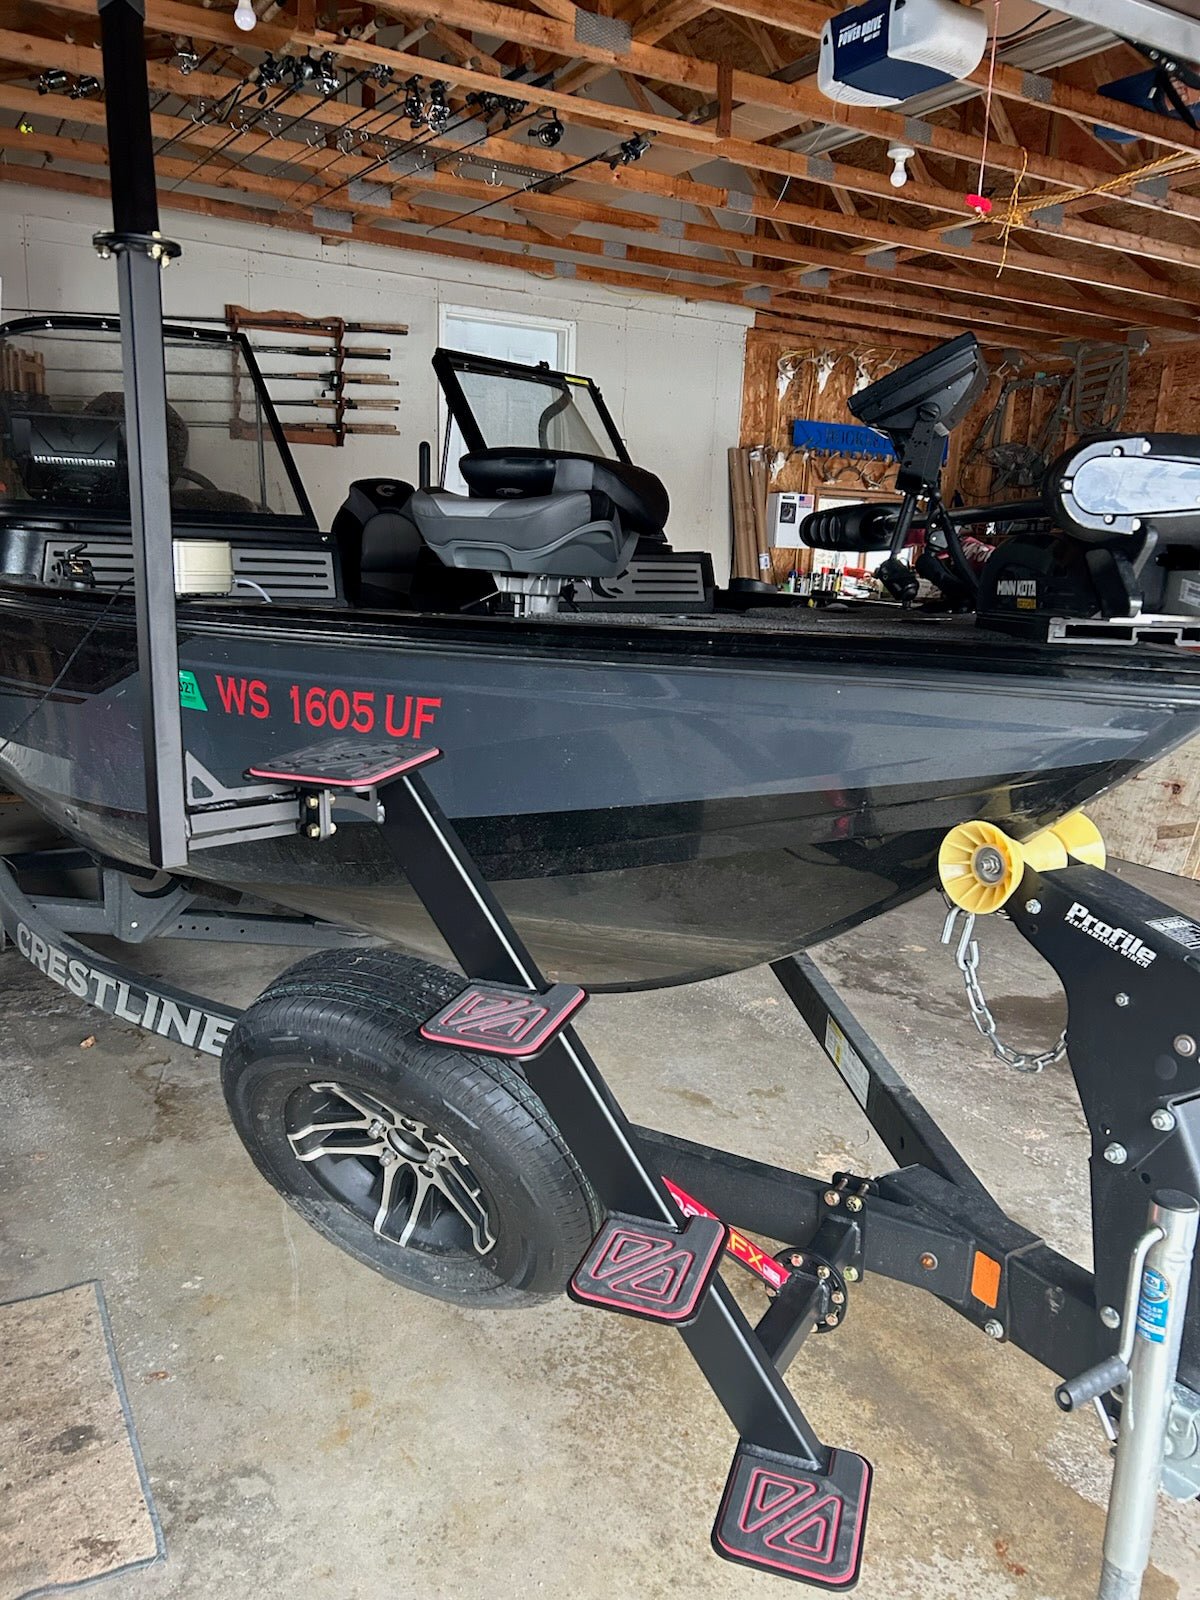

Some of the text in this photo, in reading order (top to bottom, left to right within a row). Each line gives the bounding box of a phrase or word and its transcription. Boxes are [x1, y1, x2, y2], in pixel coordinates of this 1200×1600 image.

[838, 24, 861, 48] POWER
[861, 14, 883, 37] DRIVE
[33, 455, 116, 468] HUMMINBIRD
[996, 580, 1037, 596] MINN KOTA
[214, 674, 442, 739] WS 1605 UF
[1063, 915, 1121, 952] PERFORMANCE
[1120, 949, 1153, 969] WINCH
[1065, 901, 1157, 961] Profile
[16, 921, 236, 1058] CRESTLINE
